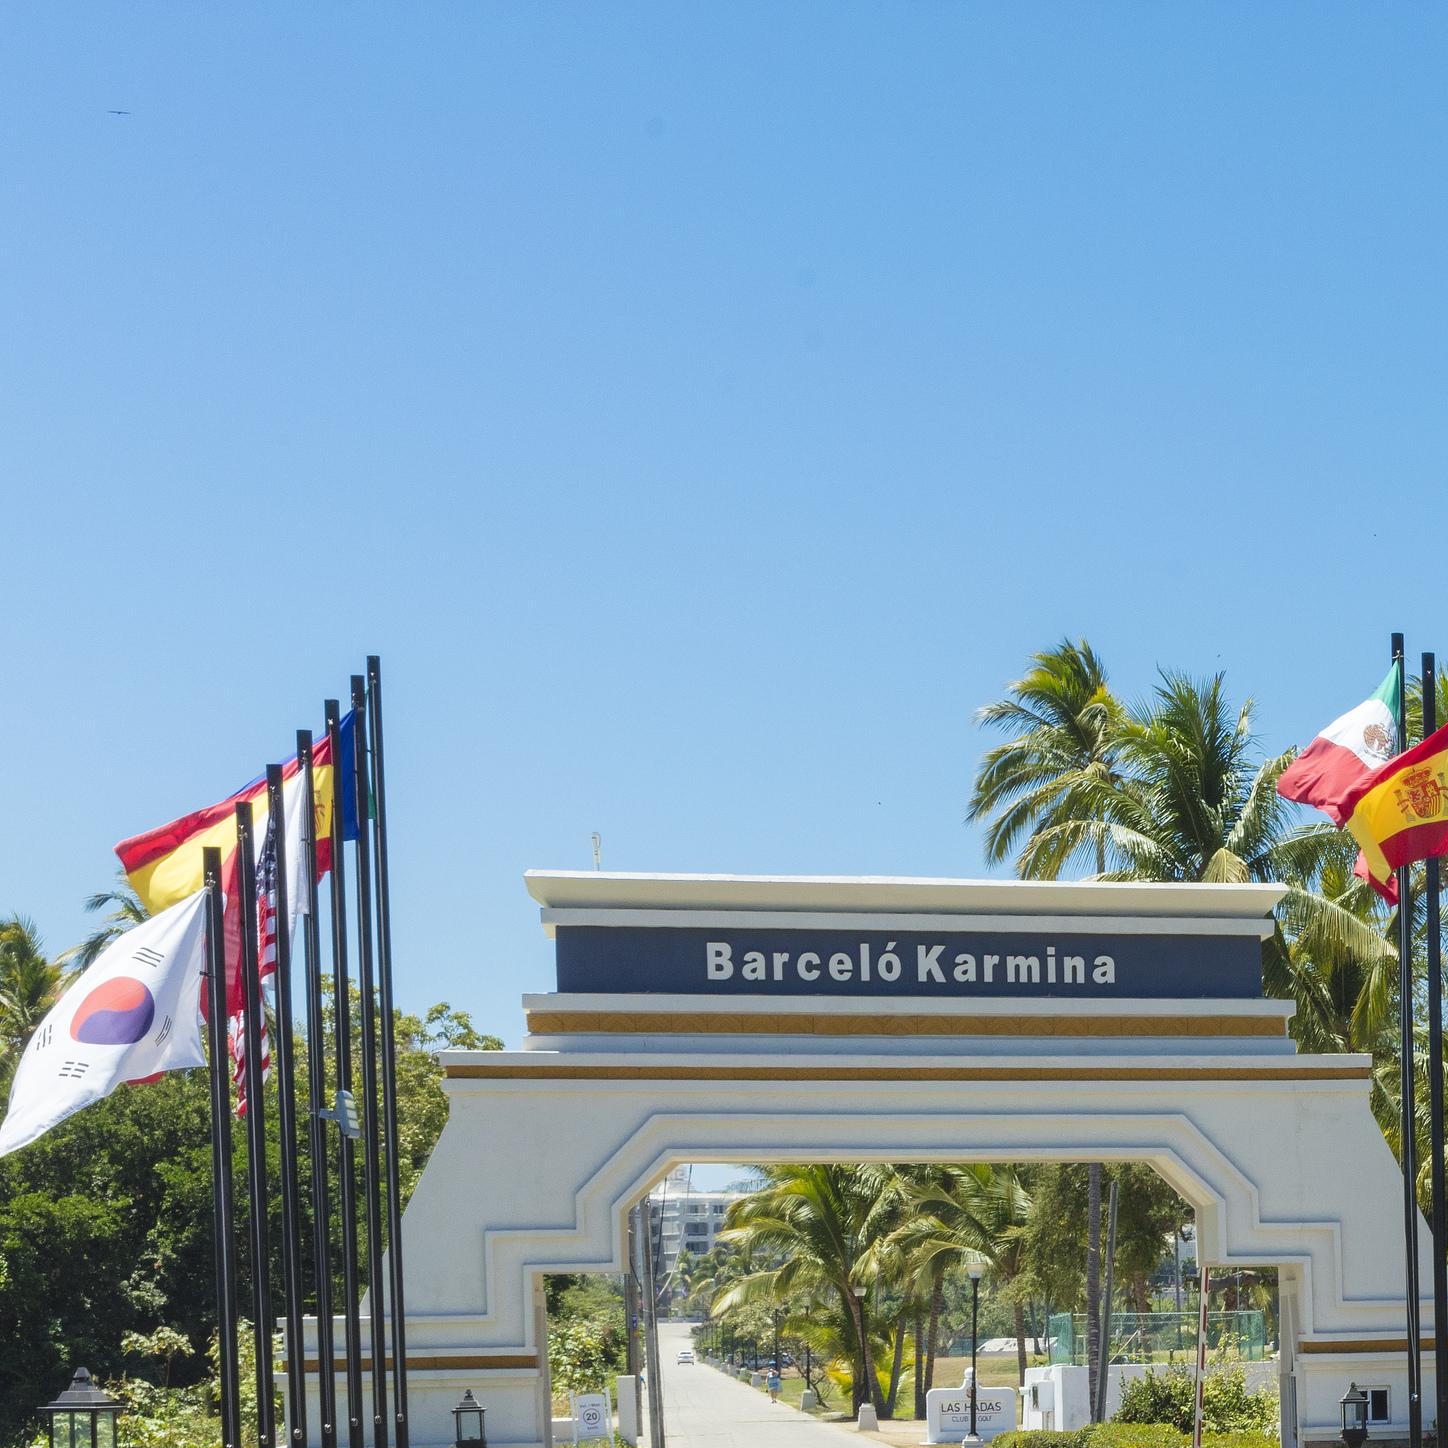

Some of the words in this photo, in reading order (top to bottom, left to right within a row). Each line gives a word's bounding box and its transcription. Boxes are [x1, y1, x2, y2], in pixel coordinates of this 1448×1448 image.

[706, 941, 901, 983] Barceló
[917, 945, 1117, 985] Karmina
[941, 1402, 961, 1413] LAS
[585, 1412, 598, 1421] 20
[951, 1415, 969, 1423] CLUB
